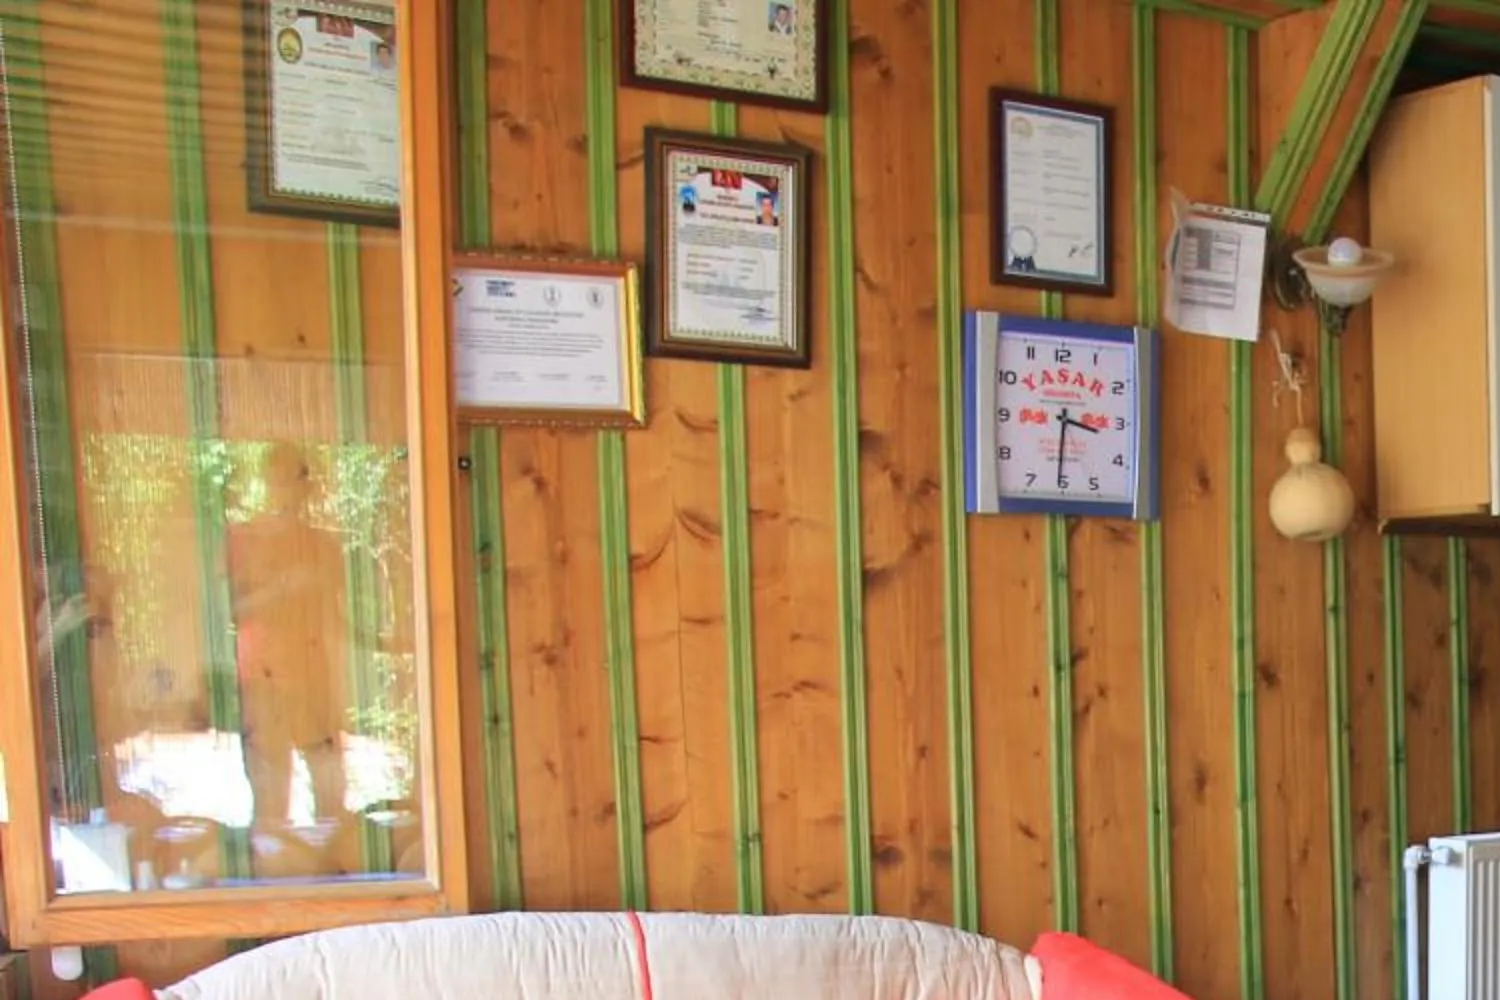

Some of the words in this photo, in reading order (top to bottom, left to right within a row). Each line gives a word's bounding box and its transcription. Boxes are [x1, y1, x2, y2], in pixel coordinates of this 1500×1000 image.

[1026, 345, 1035, 360] 11
[1055, 348, 1072, 363] 12
[1093, 352, 1099, 366] 1
[998, 370, 1017, 385] 10
[1111, 381, 1125, 395] 2
[998, 408, 1011, 422] 9
[1115, 417, 1125, 431] 3
[999, 446, 1011, 460] 8
[1112, 453, 1124, 467] 4
[1025, 473, 1037, 487] 7
[1058, 475, 1070, 489] 6
[1089, 477, 1100, 491] 5
